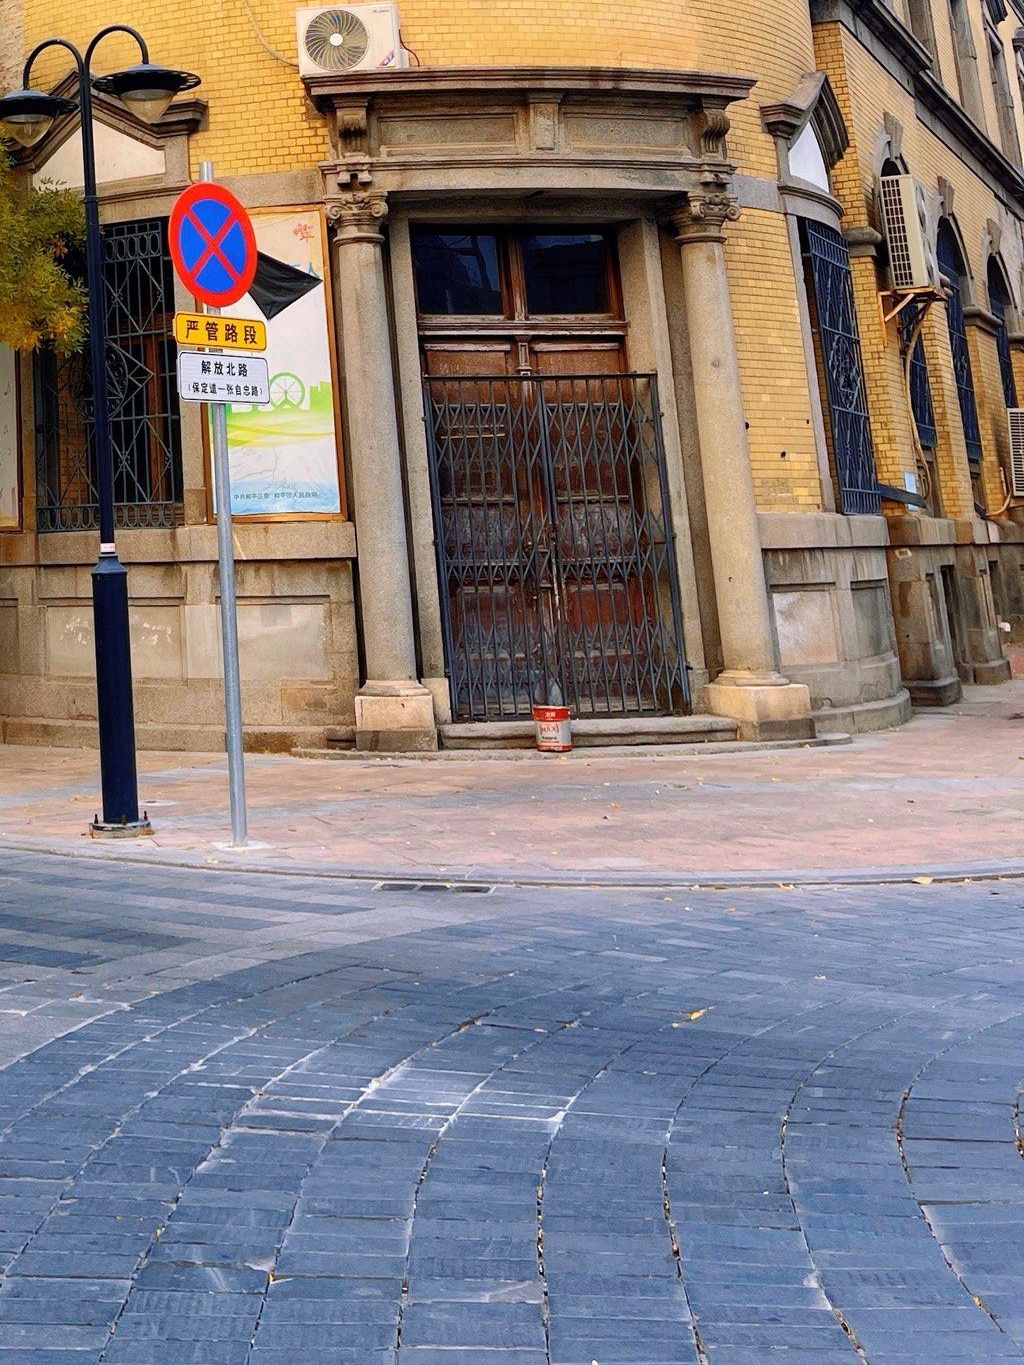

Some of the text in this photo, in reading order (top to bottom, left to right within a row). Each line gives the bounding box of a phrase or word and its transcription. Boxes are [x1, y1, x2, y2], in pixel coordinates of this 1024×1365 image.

[186, 320, 257, 344] 严管路段
[201, 360, 248, 378] 解放北路
